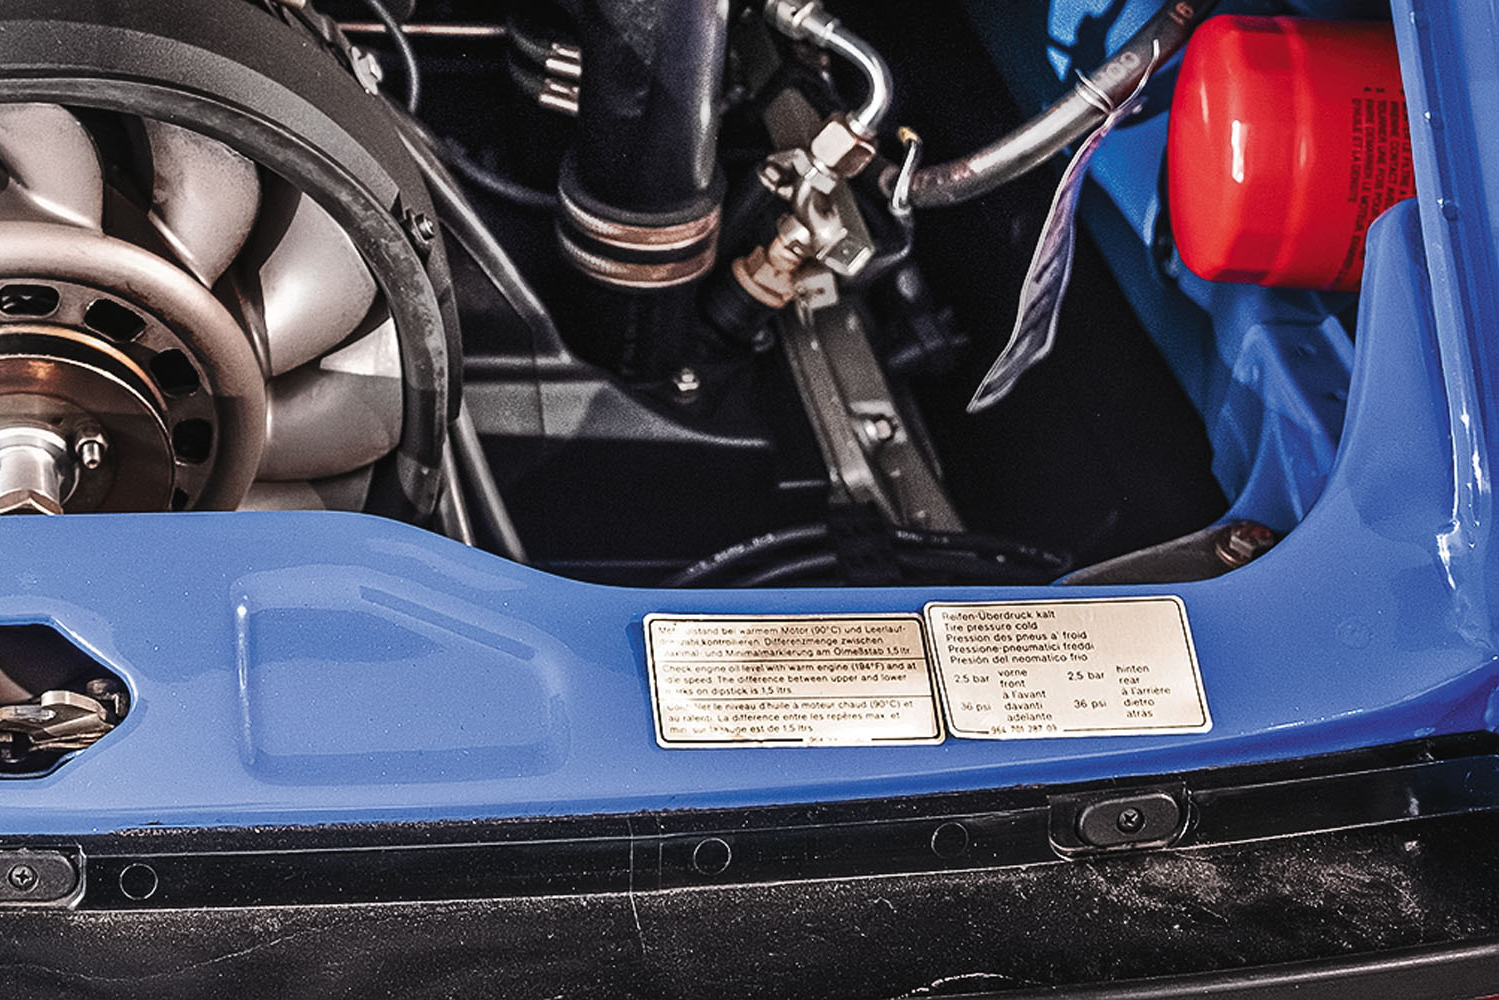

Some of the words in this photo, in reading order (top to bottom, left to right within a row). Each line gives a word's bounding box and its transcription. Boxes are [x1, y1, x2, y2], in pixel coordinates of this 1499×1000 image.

[1036, 610, 1056, 618] kalt
[780, 626, 809, 635] Motor
[845, 626, 862, 634] und
[944, 622, 963, 631] Tire
[966, 622, 1012, 632] pressure
[1015, 621, 1038, 630] cold
[841, 636, 884, 645] zwischen
[946, 634, 990, 643] Pression
[993, 633, 1012, 642] des
[1015, 632, 1048, 643] pneus
[1062, 631, 1087, 640] froid
[1063, 642, 1095, 651] freddi
[816, 648, 831, 656] am
[992, 654, 1009, 663] del
[695, 665, 726, 674] engine
[741, 664, 765, 672] level
[766, 663, 786, 672] with
[817, 663, 849, 673] engine
[886, 662, 905, 671] and
[907, 662, 917, 671] at
[1116, 665, 1149, 673] hinten
[998, 669, 1028, 677] vorne
[1087, 671, 1104, 680] bar
[716, 675, 735, 683] The
[737, 674, 784, 683] difference
[787, 674, 828, 683] between
[830, 674, 858, 683] upper
[860, 674, 878, 682] and
[880, 673, 907, 682] lower
[972, 674, 989, 683] bar
[1000, 679, 1026, 688] front
[711, 686, 749, 696] dipstick
[750, 686, 759, 695] is
[713, 702, 724, 710] le
[725, 701, 757, 710] niveau
[837, 700, 868, 709] chaud
[903, 700, 914, 708] et
[1004, 701, 1043, 710] davanti
[1073, 699, 1088, 709] 36
[1091, 700, 1107, 710] psi
[1123, 698, 1155, 707] dietro
[716, 713, 730, 722] La
[782, 713, 808, 721] entre
[809, 712, 825, 720] les
[890, 711, 901, 719] et
[1007, 712, 1052, 721] adelante
[749, 724, 764, 733] est
[766, 723, 780, 732] de
